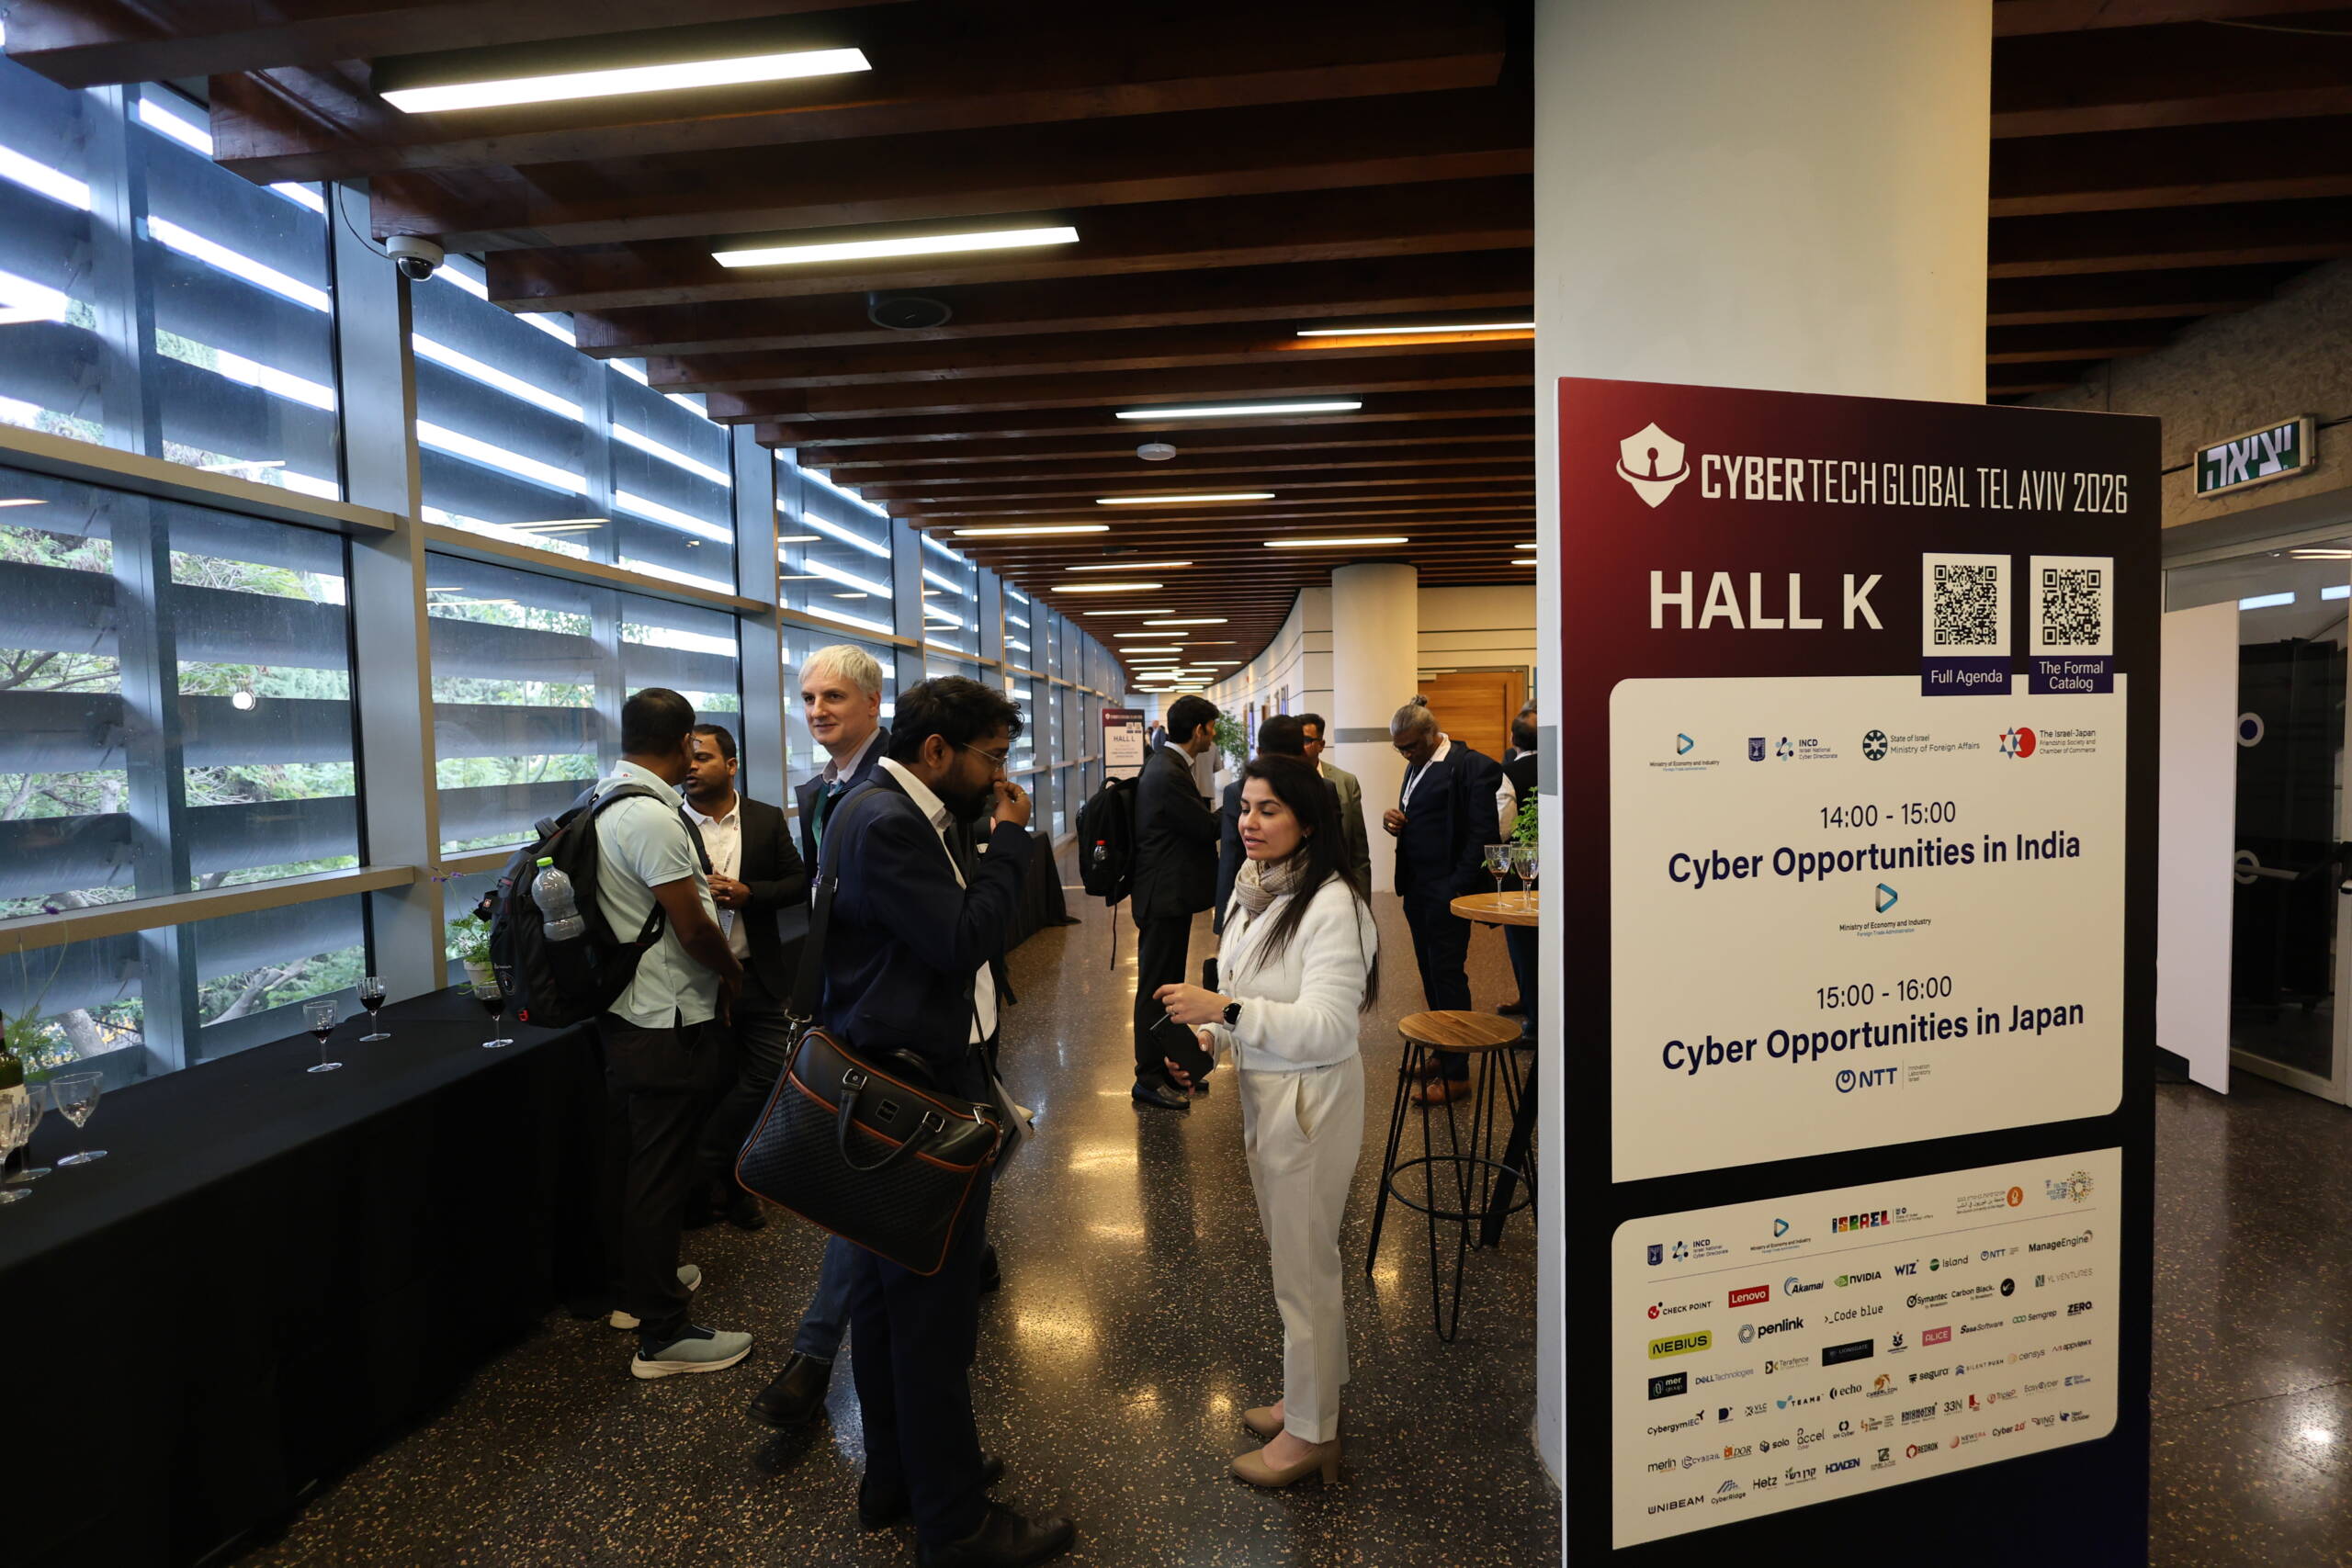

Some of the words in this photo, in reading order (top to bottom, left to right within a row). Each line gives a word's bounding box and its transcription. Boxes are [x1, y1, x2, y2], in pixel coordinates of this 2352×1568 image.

[2207, 424, 2291, 490] יציאה
[1883, 461, 1971, 509] GLOBAL
[1977, 468, 2013, 511] TEL
[2018, 470, 2065, 513] AVIV
[2074, 473, 2128, 514] 2026
[1650, 570, 1823, 630] HALL
[1844, 573, 1884, 631] K
[2040, 661, 2064, 675] The
[2067, 660, 2104, 675] Formal
[1931, 670, 1952, 684] Full
[1956, 669, 2003, 687] Agenda
[2049, 675, 2094, 693] Catalog
[1799, 739, 1818, 747] INCD
[1891, 735, 1906, 743] State
[1906, 734, 1914, 742] of
[1915, 734, 1930, 742] Israel
[1890, 746, 1919, 754] Ministry
[1920, 745, 1928, 753] of
[1929, 743, 1956, 752] Foreign
[1958, 741, 1980, 750] Affairs
[1820, 805, 1878, 829] 14:00
[1901, 801, 1956, 825] 15:00
[1668, 850, 1763, 889] Cyber
[1772, 837, 1975, 882] Opportunities
[1984, 834, 2007, 863] in
[2016, 830, 2081, 861] India
[1839, 923, 1863, 931] Ministry
[1871, 920, 1896, 930] Economy
[1908, 918, 1932, 927] Industry
[1816, 983, 1874, 1010] 15:00
[1896, 976, 1952, 1001] 16:00
[1662, 1035, 1758, 1076] Cyber
[1767, 1012, 1968, 1064] Opportunities
[1976, 1007, 2000, 1035] in
[2008, 1003, 2084, 1035] Japan
[1859, 1067, 1897, 1089] NTT
[1832, 1210, 1891, 1234] ISRAEL
[1693, 1239, 1711, 1247] INCD
[2029, 1235, 2089, 1253] ManageEngine
[1990, 1249, 2007, 1258] NTT
[1894, 1262, 1917, 1277] WIZ
[1792, 1280, 1824, 1294] Akamai
[1951, 1289, 1974, 1298] Carbon
[1732, 1290, 1766, 1303] Lenovo
[1917, 1293, 1948, 1305] Symantec
[1663, 1306, 1688, 1315] CHECK
[1689, 1302, 1712, 1312] POINT
[1860, 1305, 1884, 1317] blue
[2067, 1301, 2093, 1314] ZERO
[2028, 1310, 2058, 1322] Semgrep
[1758, 1316, 1804, 1338] penlink
[1925, 1330, 1949, 1343] ALICE
[1653, 1335, 1708, 1355] NEBIUS
[1919, 1368, 1950, 1381] segura
[1838, 1383, 1862, 1396] echo
[1754, 1403, 1768, 1412] VLC
[1944, 1399, 1963, 1413] 33N
[1797, 1428, 1826, 1445] accel
[1992, 1427, 2013, 1438] Cyber
[1772, 1438, 1790, 1450] solo
[1753, 1475, 1778, 1491] Hetz
[1647, 1495, 1704, 1515] UNIBEAM
